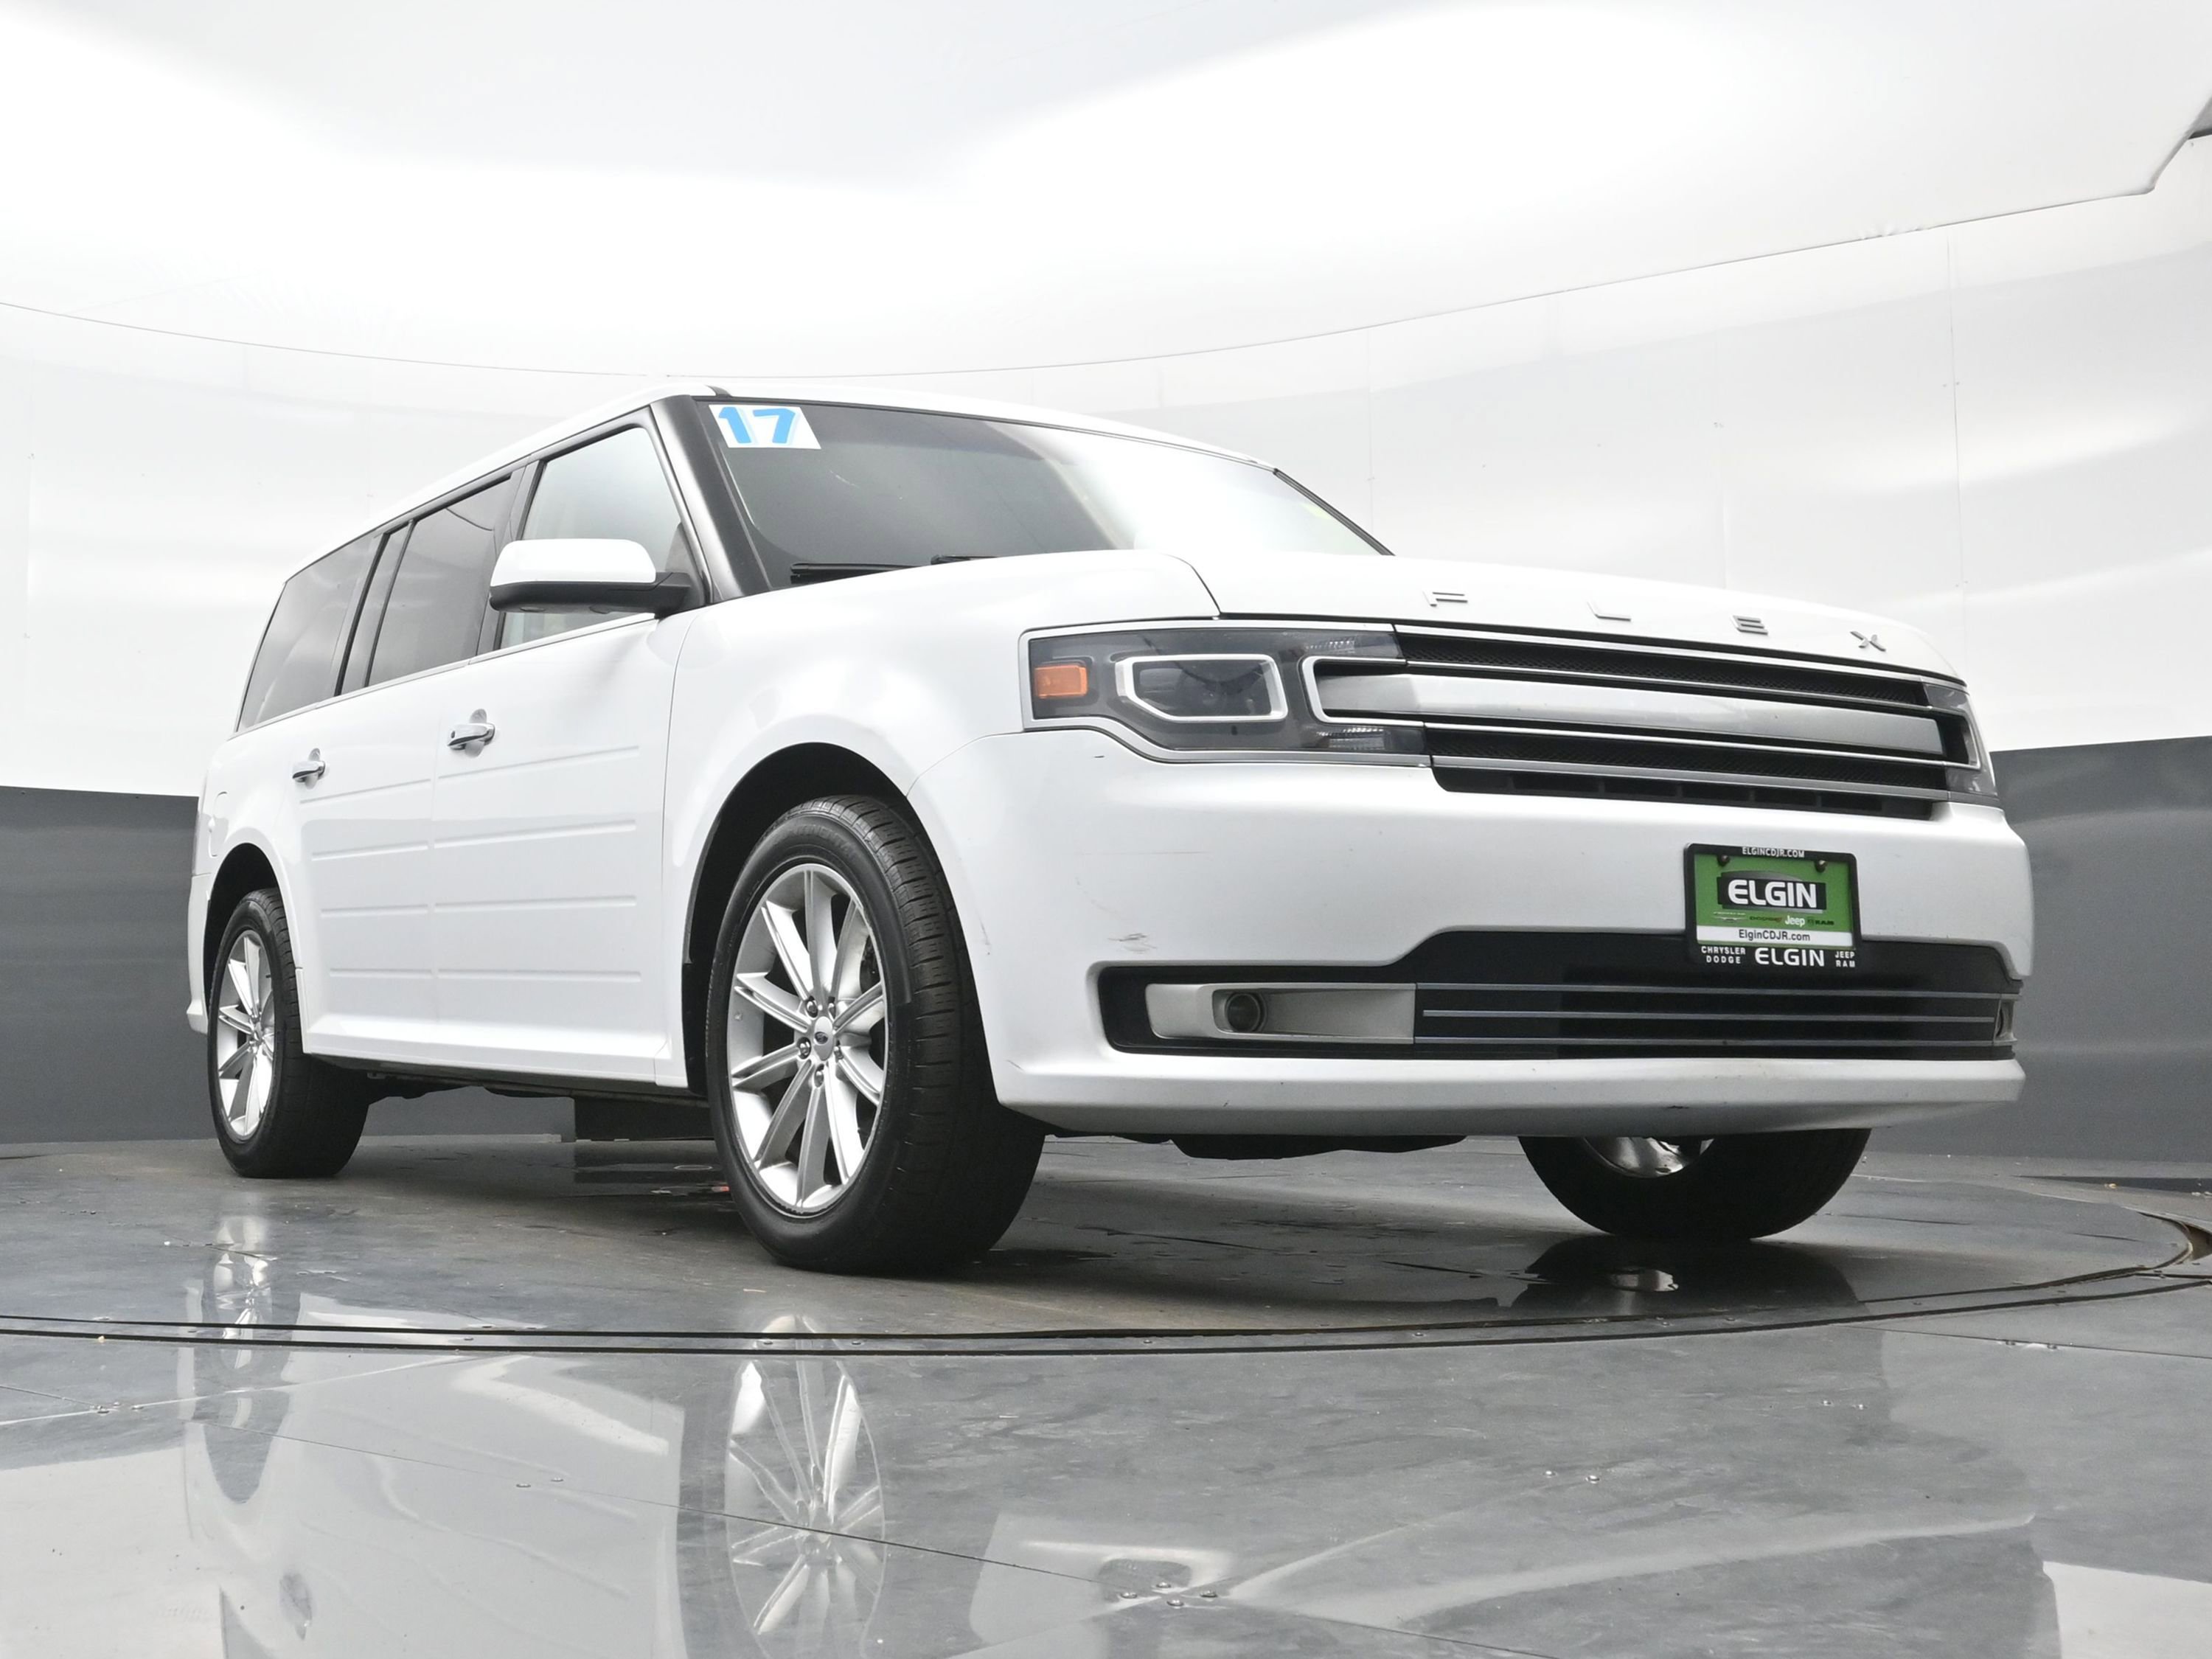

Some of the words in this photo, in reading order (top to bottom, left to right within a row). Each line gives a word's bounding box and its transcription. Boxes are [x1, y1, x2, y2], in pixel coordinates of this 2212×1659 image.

[718, 406, 797, 444] 17
[1423, 589, 1886, 652] FLEX
[1742, 846, 1805, 858] ELGINCDJR.COM
[1728, 879, 1817, 908] ELGIN
[1784, 915, 1806, 928] Jeep
[1739, 929, 1810, 942] ElginCDJR.com
[1701, 945, 1746, 956] CHRYSLER
[1755, 947, 1825, 967] ELGIN
[1834, 951, 1855, 959] JEEP
[1706, 956, 1741, 964] DODGE
[1835, 959, 1856, 968] RAM
